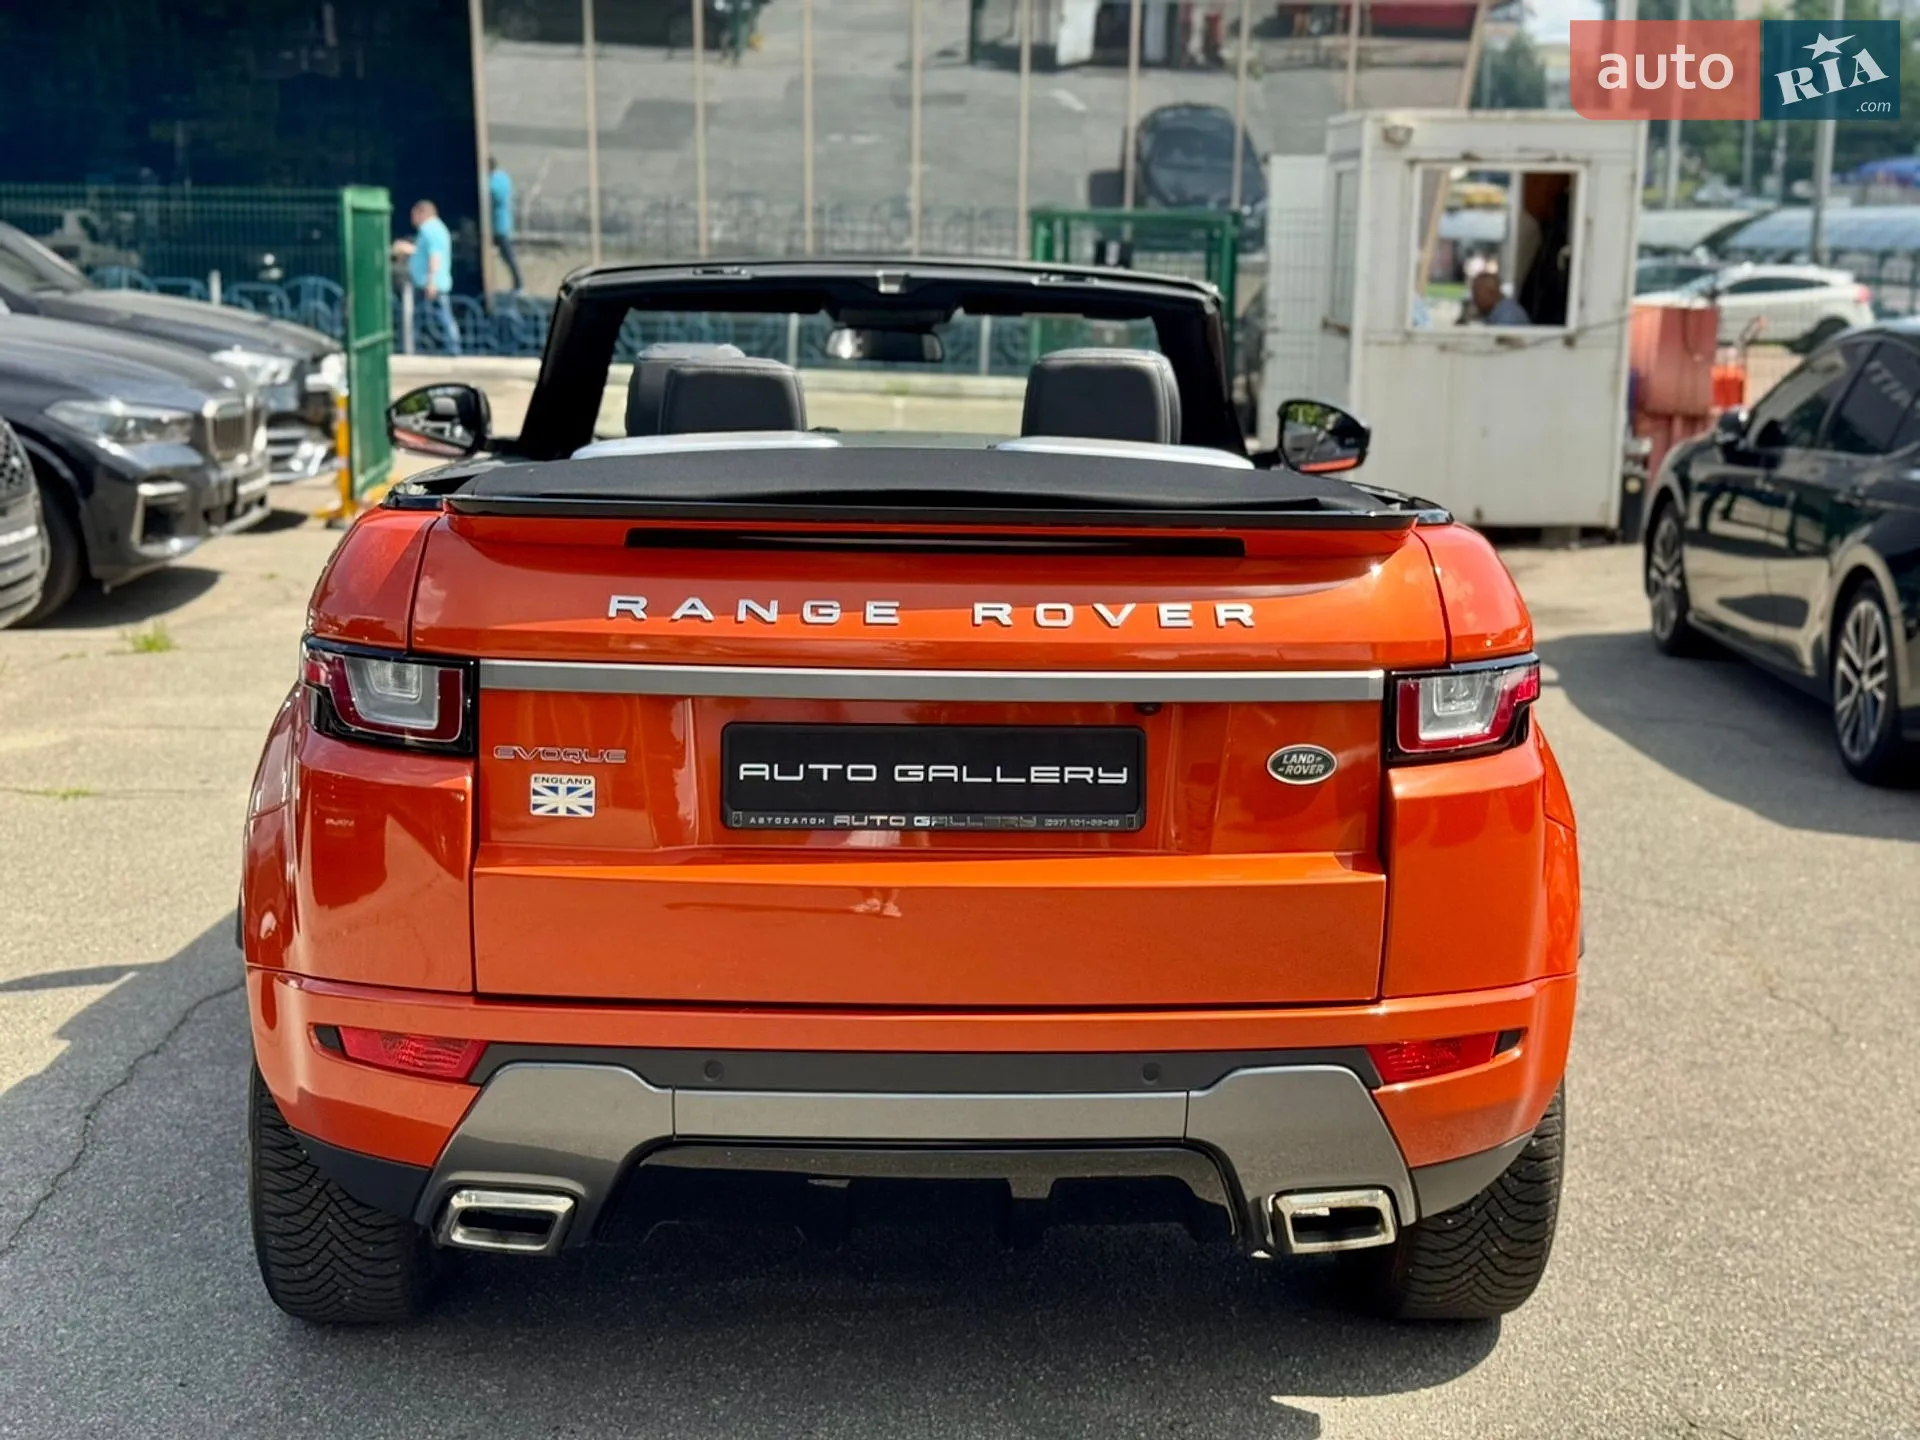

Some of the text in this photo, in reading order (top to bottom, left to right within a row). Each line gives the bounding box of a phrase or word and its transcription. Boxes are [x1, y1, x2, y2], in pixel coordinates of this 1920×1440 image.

[608, 594, 1256, 629] RANGE ROVER
[493, 745, 627, 764] EVOQUE
[533, 775, 592, 785] ENGLAND
[738, 763, 1129, 785] AUTO GALLERY
[833, 815, 906, 827] AUTO
